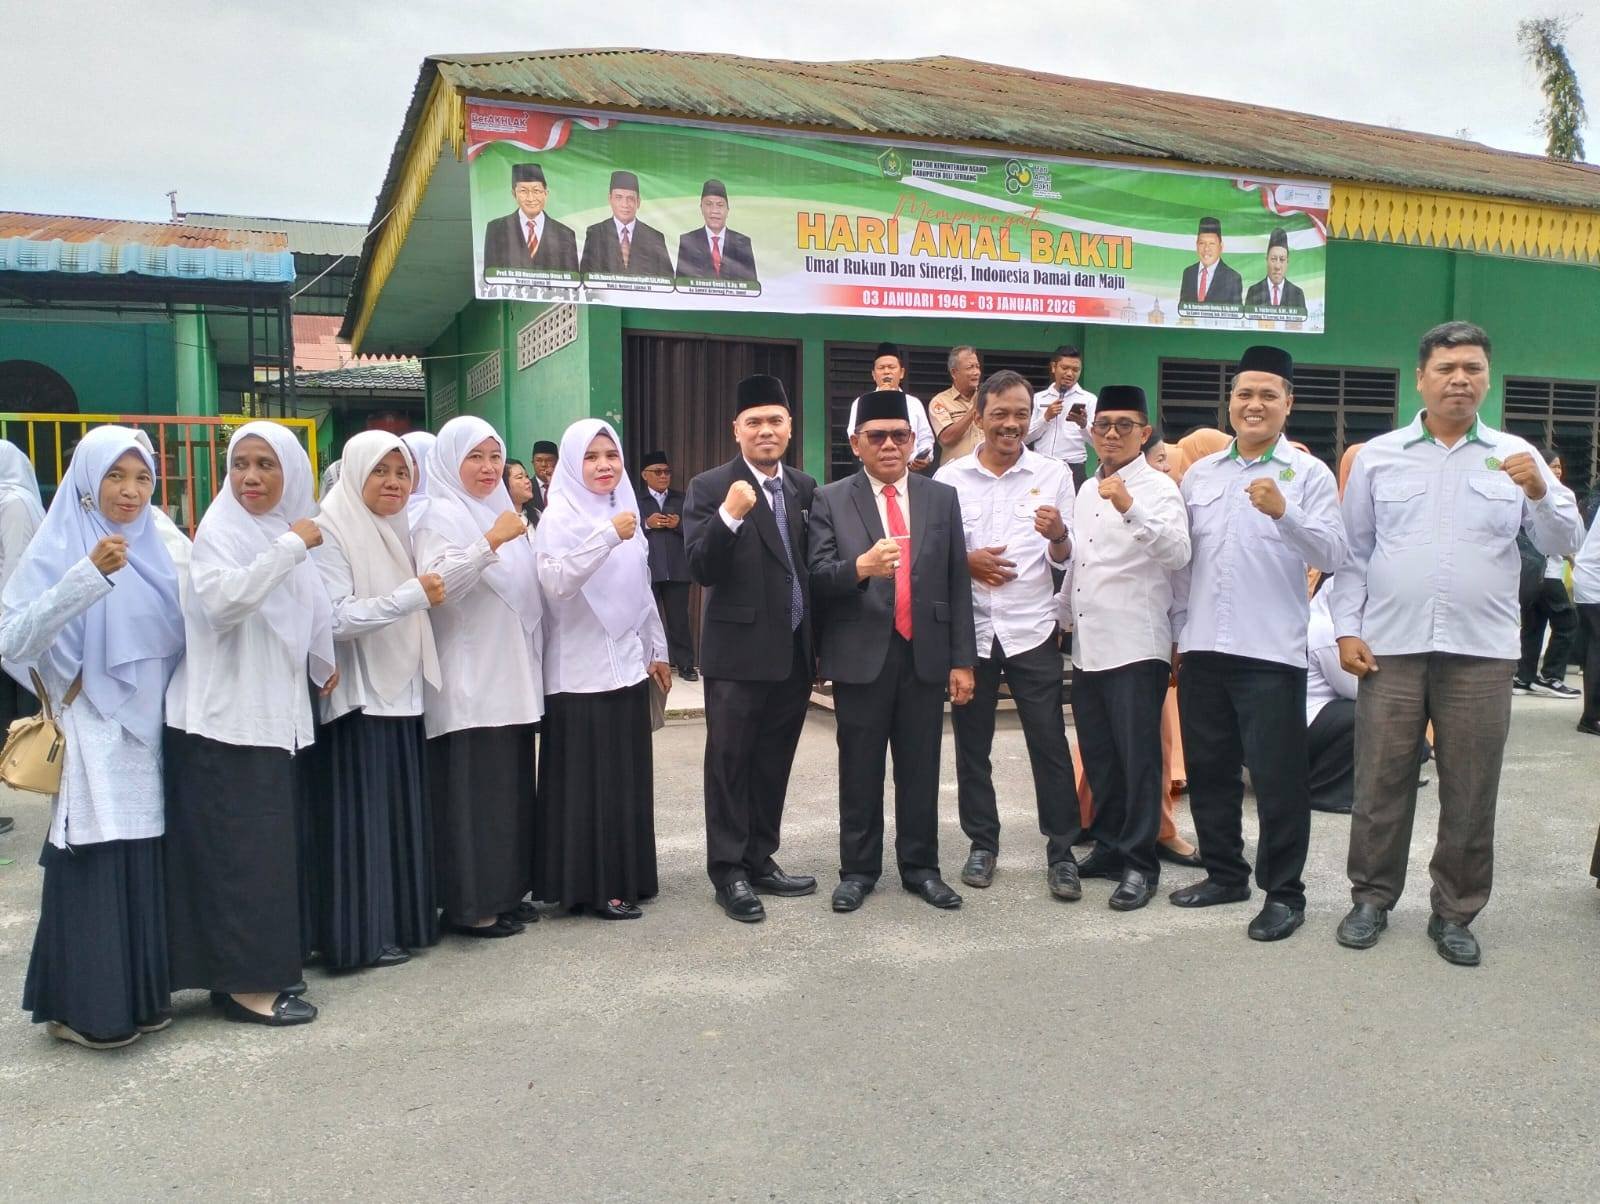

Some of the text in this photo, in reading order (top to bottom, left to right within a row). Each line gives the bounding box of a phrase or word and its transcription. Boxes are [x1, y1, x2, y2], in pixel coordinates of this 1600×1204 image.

[912, 160, 987, 173] KANTOR KEMENTERIAN AGAMA
[912, 170, 941, 178] KABUPATEN
[954, 173, 977, 181] SERDANG
[797, 211, 1133, 269] HARI AMAL BAKTI
[805, 255, 1125, 291] Umat Rukun Dan Sinergi, Indonesia Damai dan Maju
[862, 290, 880, 306] 03
[883, 291, 933, 308] JANUARI
[937, 293, 967, 309] 1946
[978, 296, 993, 311] 03
[997, 296, 1044, 312] JANUARI
[1047, 300, 1076, 313] 2026
